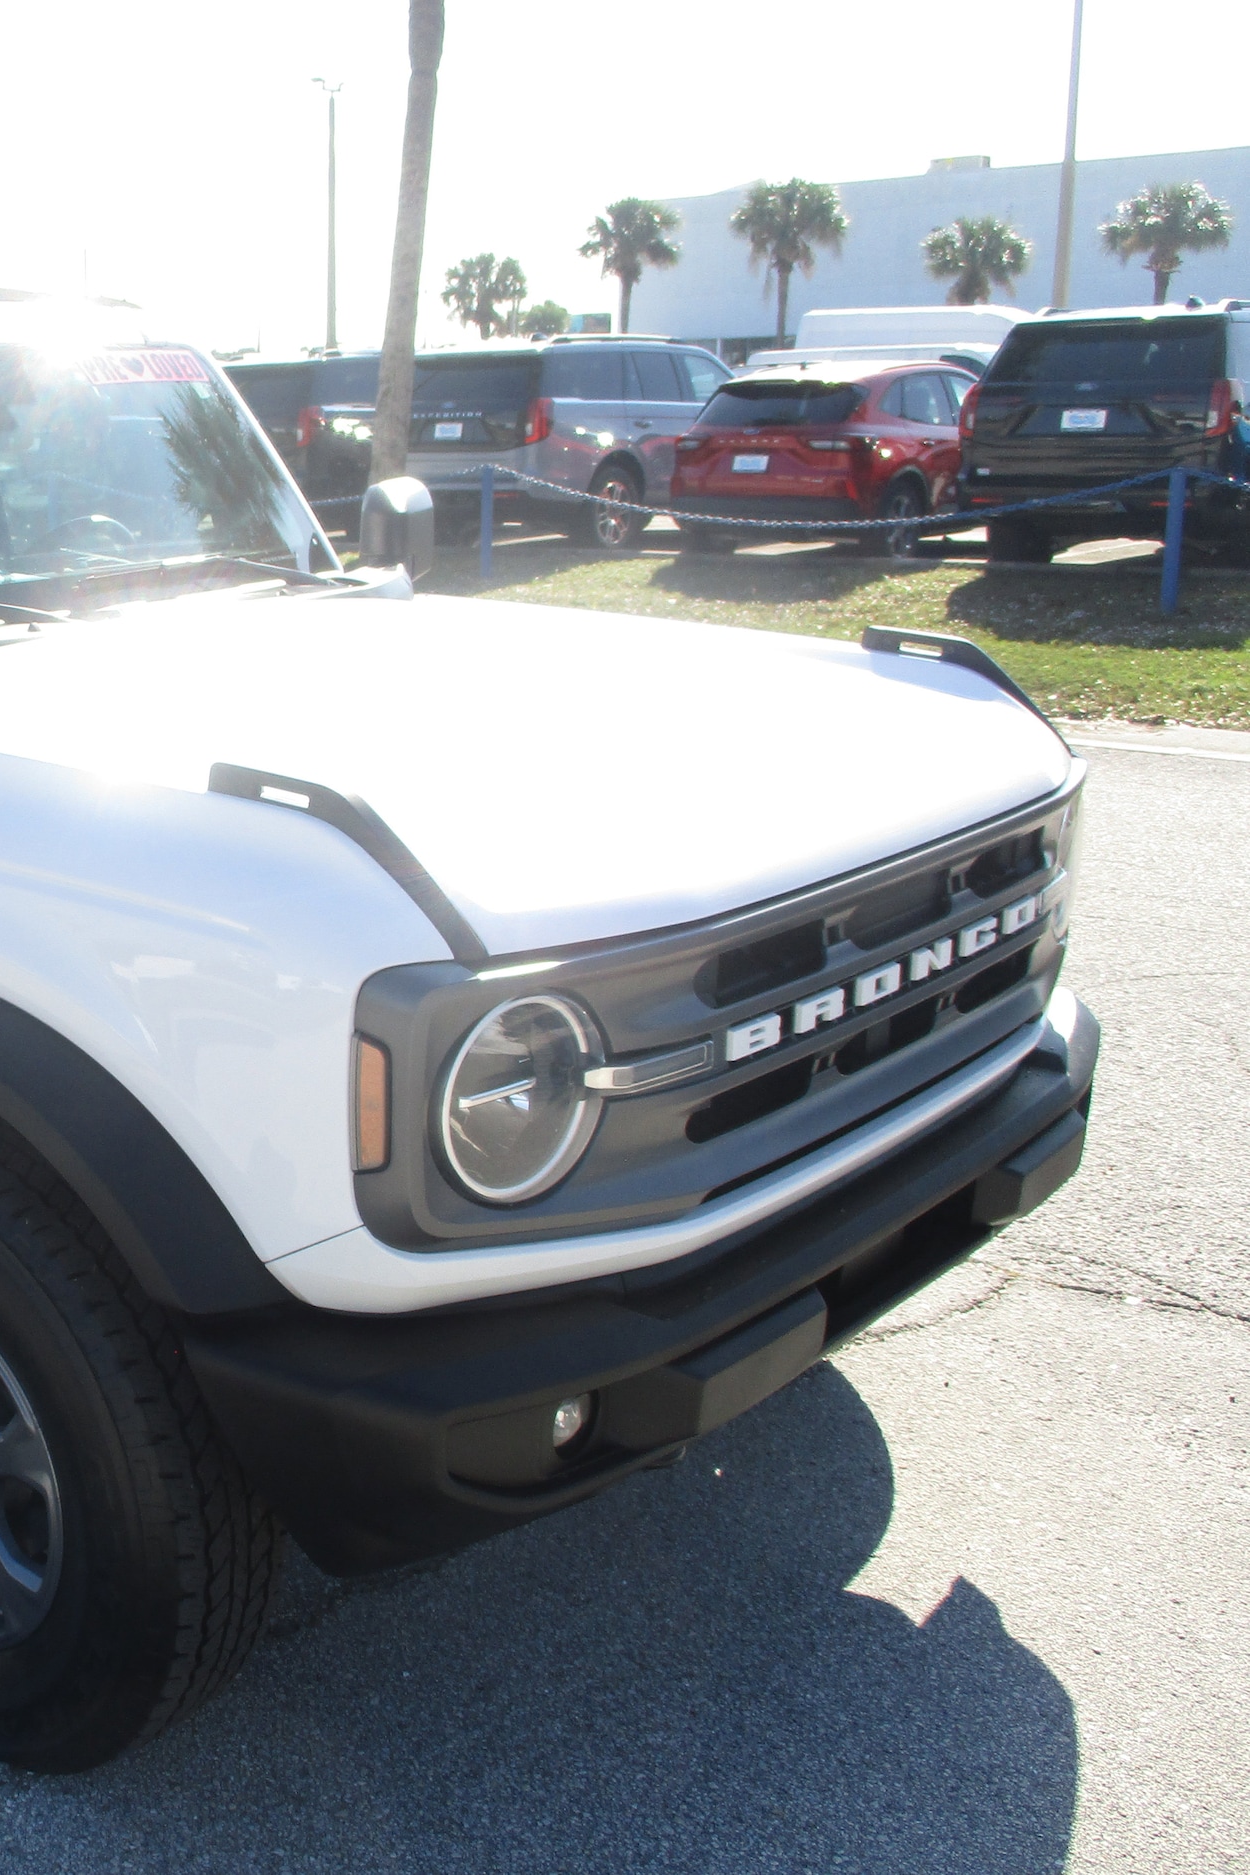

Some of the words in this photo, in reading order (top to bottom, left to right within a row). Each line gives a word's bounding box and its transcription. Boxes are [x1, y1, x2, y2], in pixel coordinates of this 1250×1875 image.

[141, 352, 205, 380] LOVED
[413, 411, 482, 419] PEDITION
[726, 894, 1038, 1062] BRONCO
